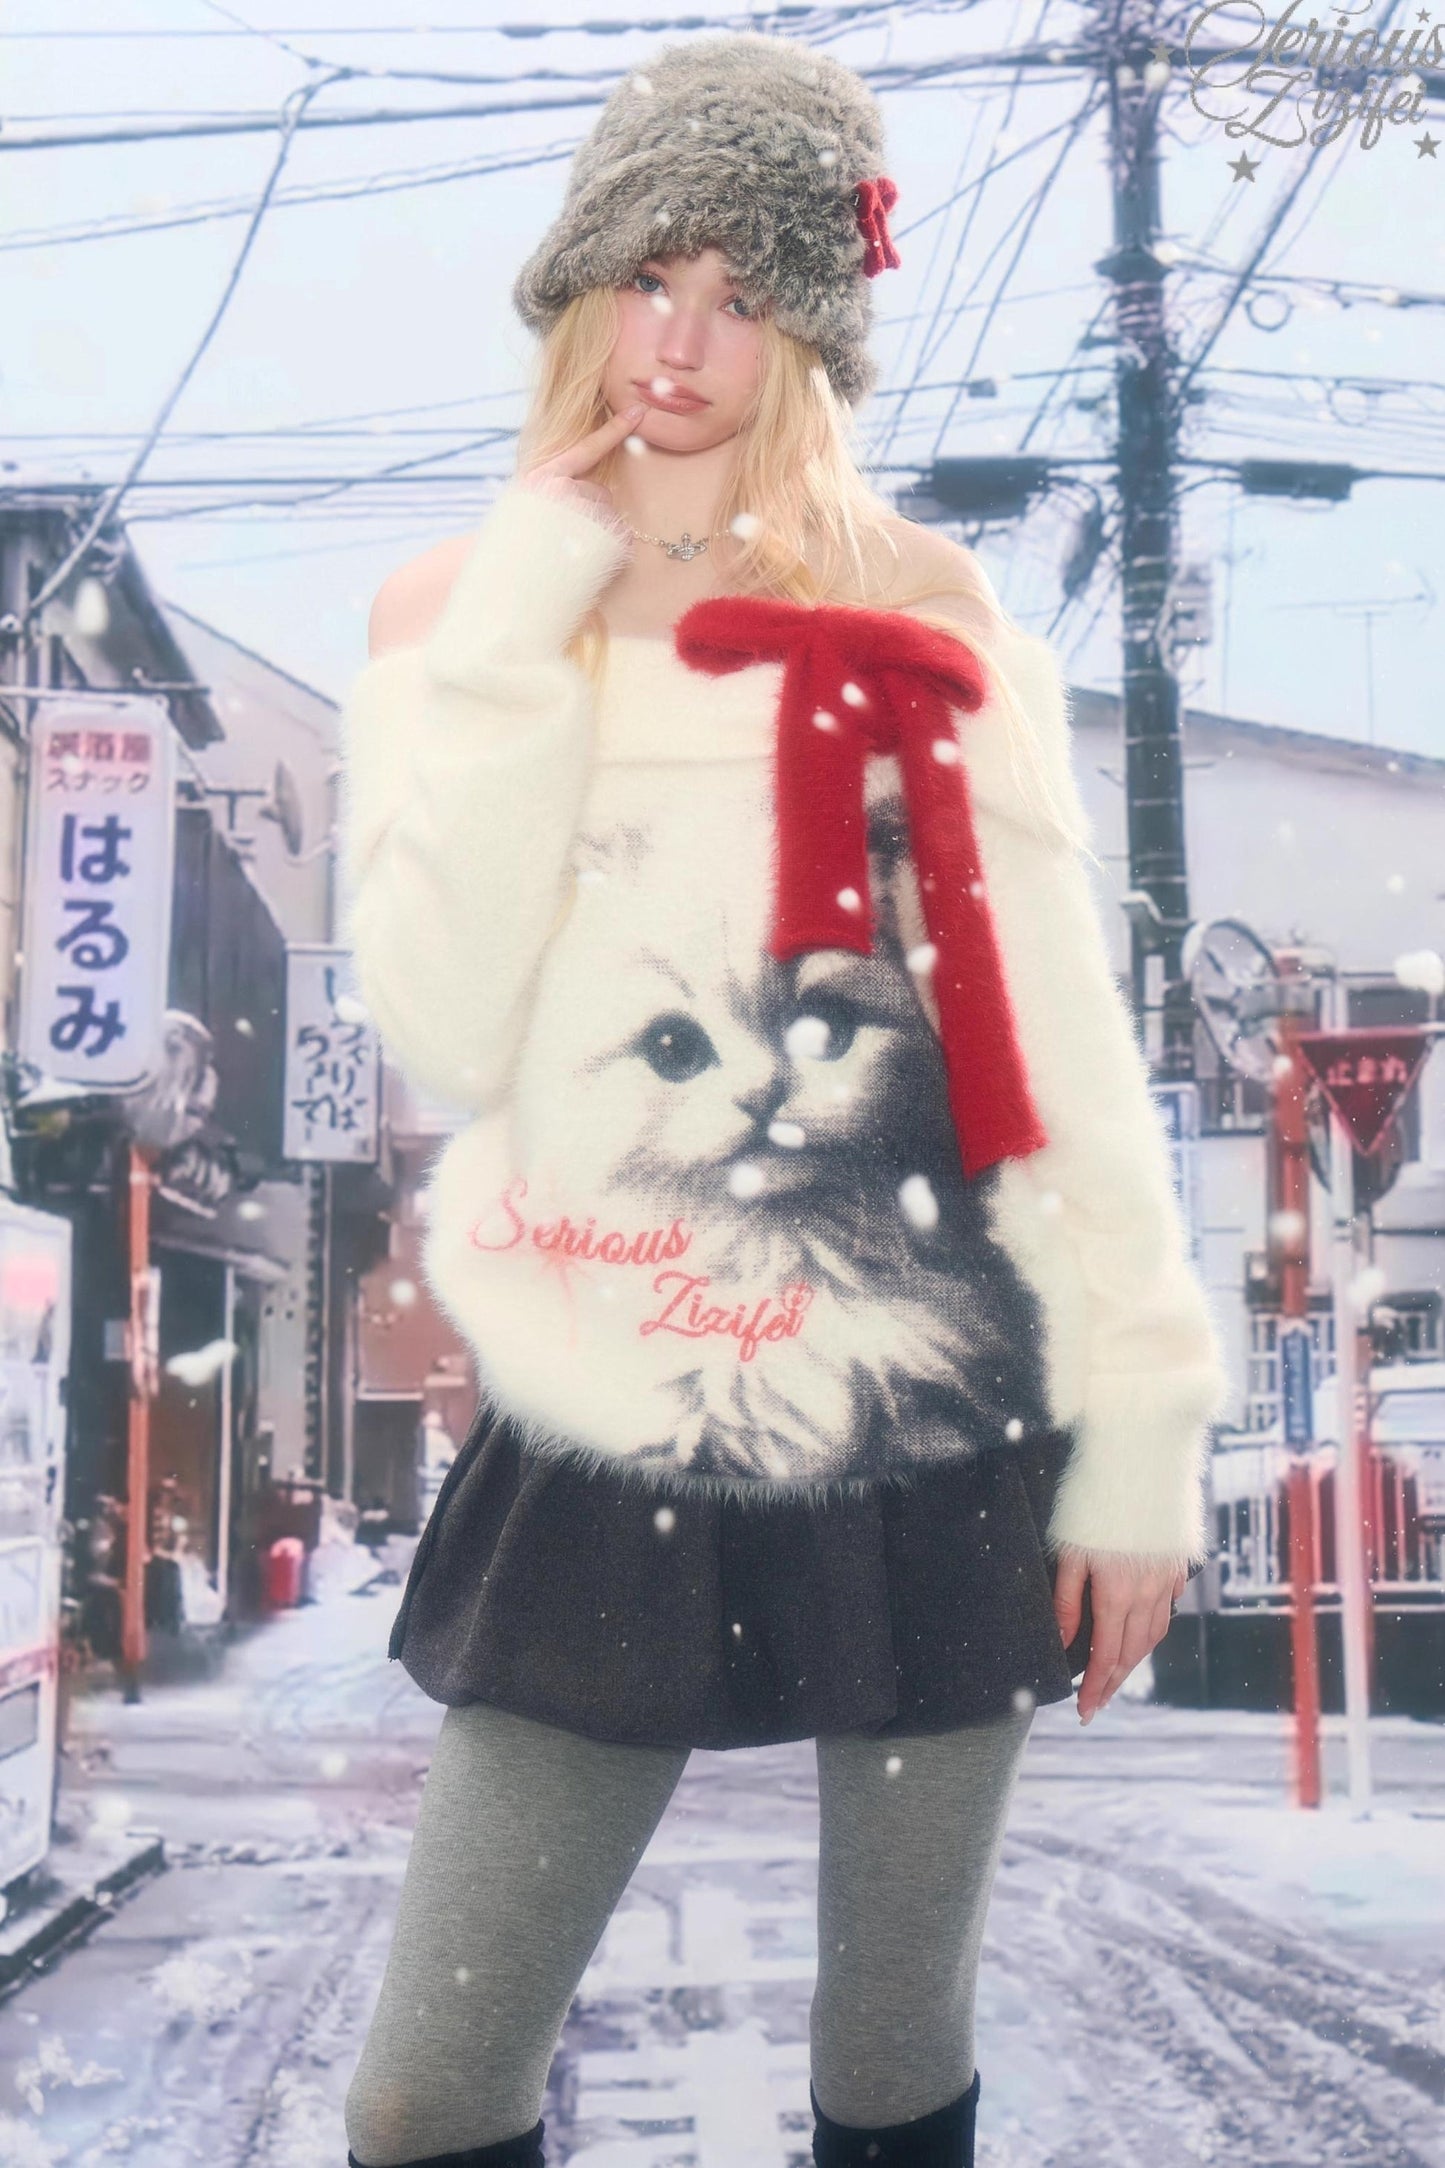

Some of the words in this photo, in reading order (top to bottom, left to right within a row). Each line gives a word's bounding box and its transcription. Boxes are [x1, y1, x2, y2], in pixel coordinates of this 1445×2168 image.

[46, 767, 151, 794] スナック
[50, 813, 133, 1059] はるみ
[467, 1175, 693, 1266] Serious
